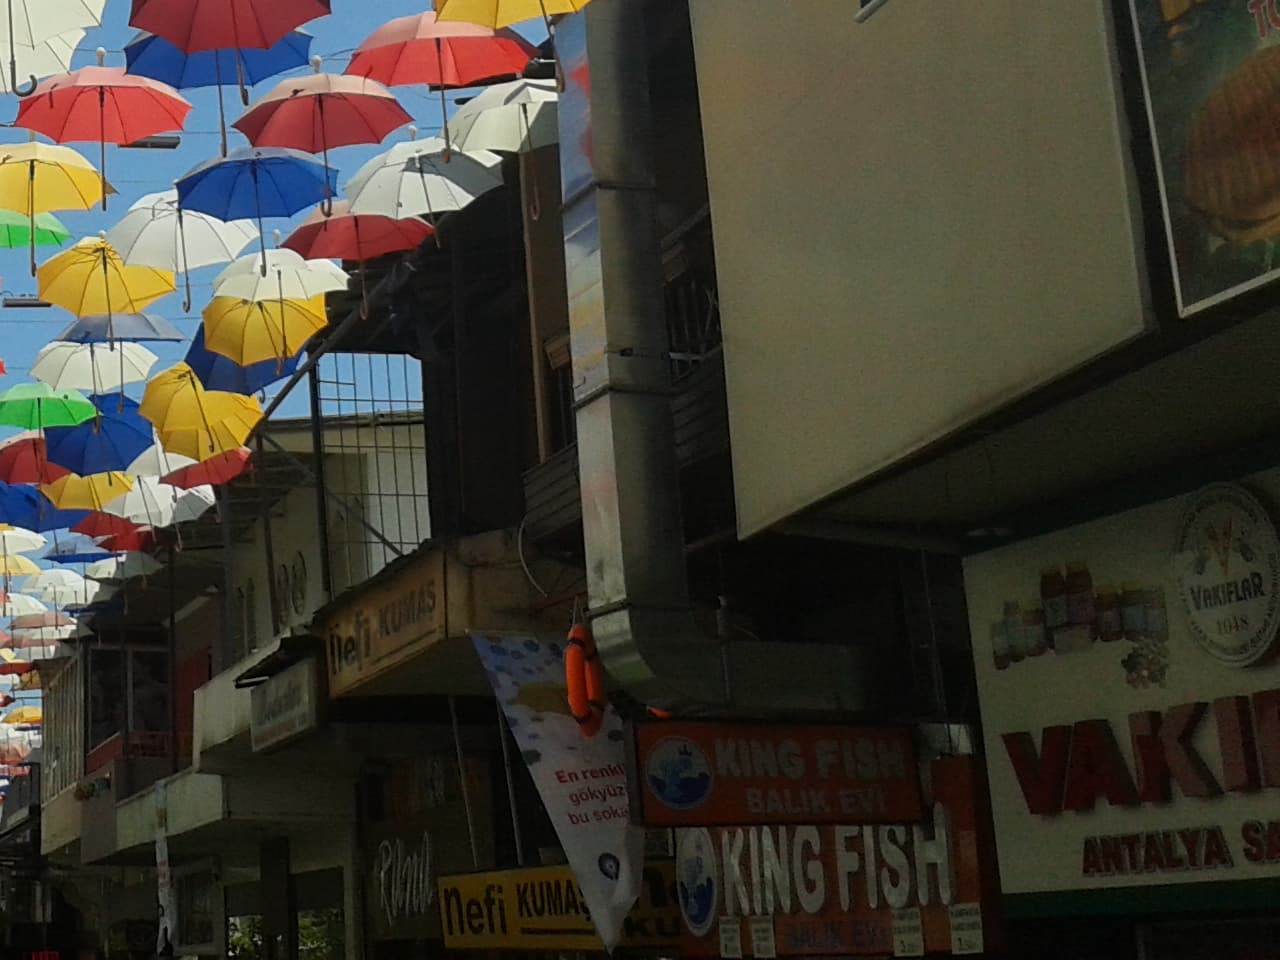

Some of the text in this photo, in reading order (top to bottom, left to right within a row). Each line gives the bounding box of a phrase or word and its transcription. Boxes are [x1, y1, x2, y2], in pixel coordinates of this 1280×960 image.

[1190, 571, 1265, 611] VAKIFLAR
[555, 770, 579, 784] En
[714, 736, 906, 780] KING FISH
[568, 812, 590, 825] bu
[746, 787, 831, 814] BALIK
[722, 824, 826, 916] KING
[833, 800, 952, 914] FISH
[1082, 826, 1234, 877] ANTALYA
